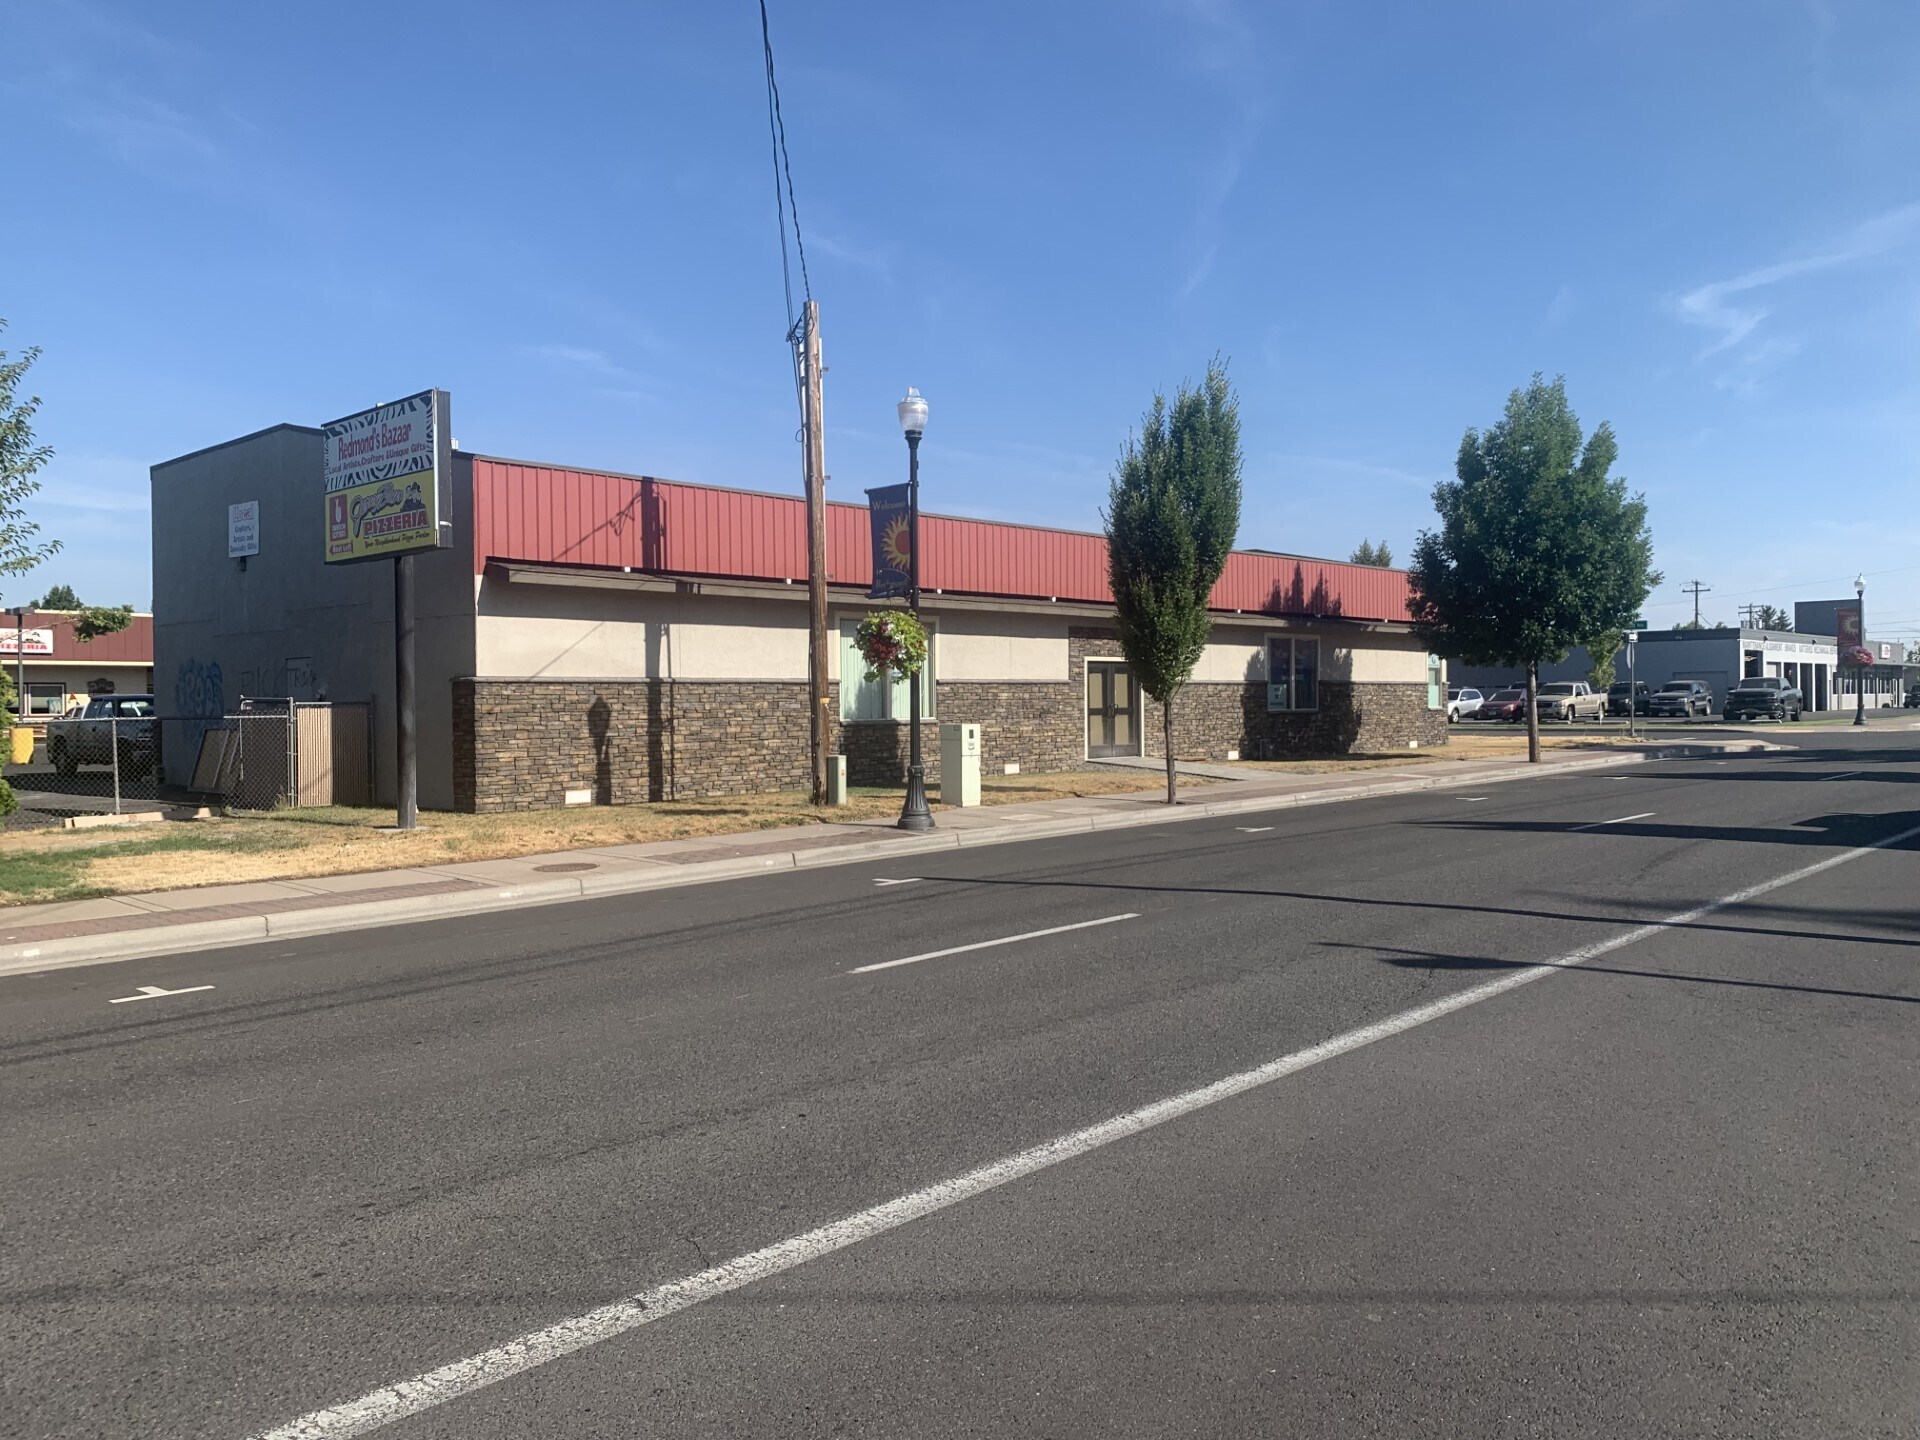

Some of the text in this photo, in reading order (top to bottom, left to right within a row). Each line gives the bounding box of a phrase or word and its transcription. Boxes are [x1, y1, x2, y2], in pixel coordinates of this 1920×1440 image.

[339, 423, 411, 461] Redmond's Bazaar
[328, 462, 342, 474] Local
[872, 501, 907, 511] Welcome
[364, 510, 429, 537] PIZZERIA
